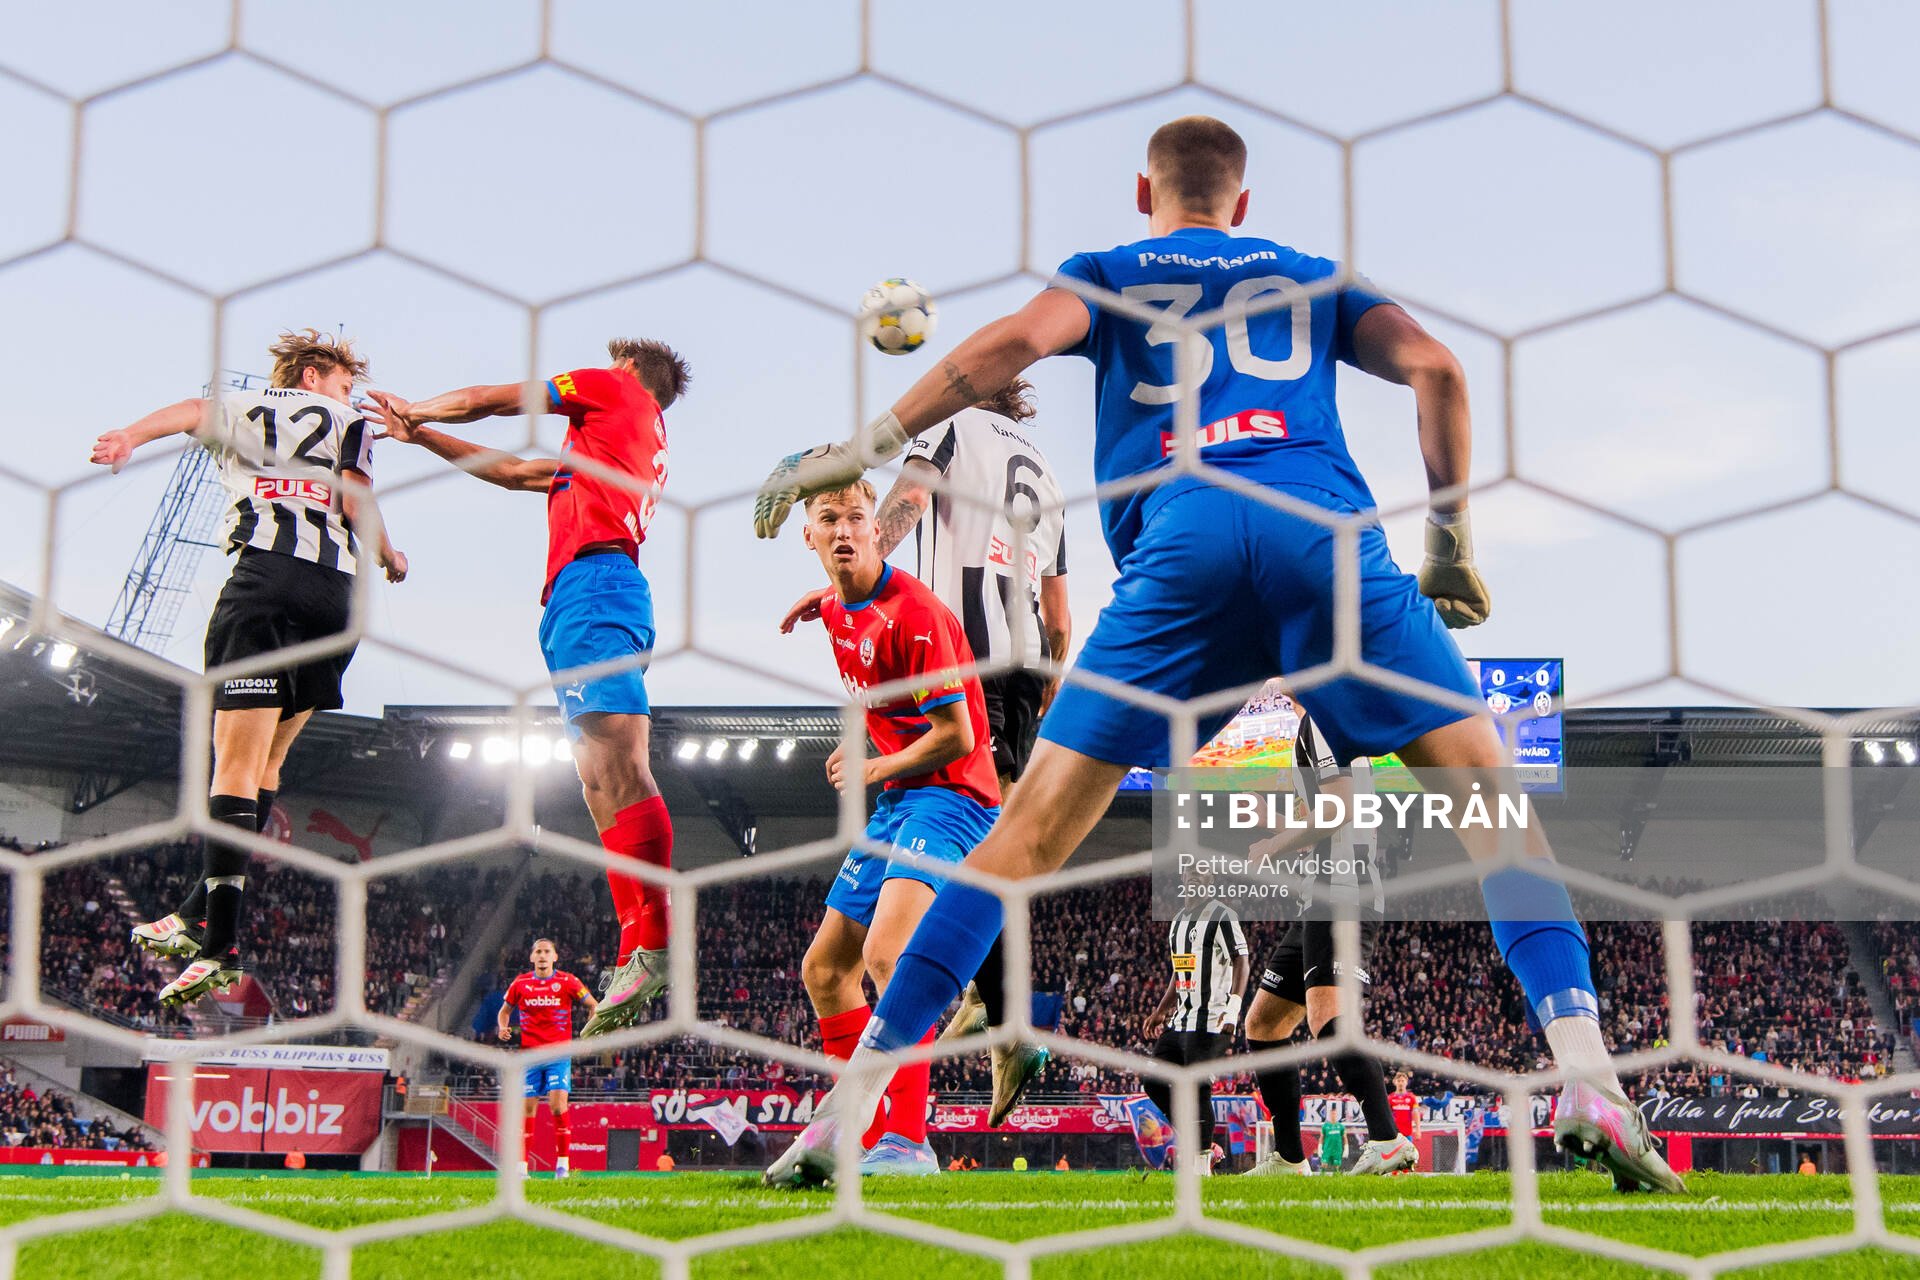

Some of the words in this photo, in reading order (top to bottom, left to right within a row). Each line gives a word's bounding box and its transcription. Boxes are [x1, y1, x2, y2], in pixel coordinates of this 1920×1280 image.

[1120, 274, 1313, 406] 30
[246, 405, 334, 470] 12
[256, 479, 330, 502] PULS
[1003, 454, 1044, 534] 6
[990, 536, 1038, 581] PUS
[224, 678, 279, 689] FLYTGOLV
[1491, 668, 1506, 687] 0
[1535, 668, 1550, 687] 0
[1513, 746, 1551, 758] CHVÄRD
[910, 837, 926, 851] 19
[524, 995, 562, 1007] vobbiz
[4, 1024, 49, 1040] PUMA
[347, 1053, 385, 1064] BUSS
[186, 1086, 346, 1135] vobbiz
[1008, 1109, 1059, 1130] Carlsberg
[1639, 1096, 1706, 1122] Vila
[1714, 1102, 1727, 1118] i
[1728, 1099, 1793, 1130] frid
[1796, 1098, 1910, 1124] Sveker
